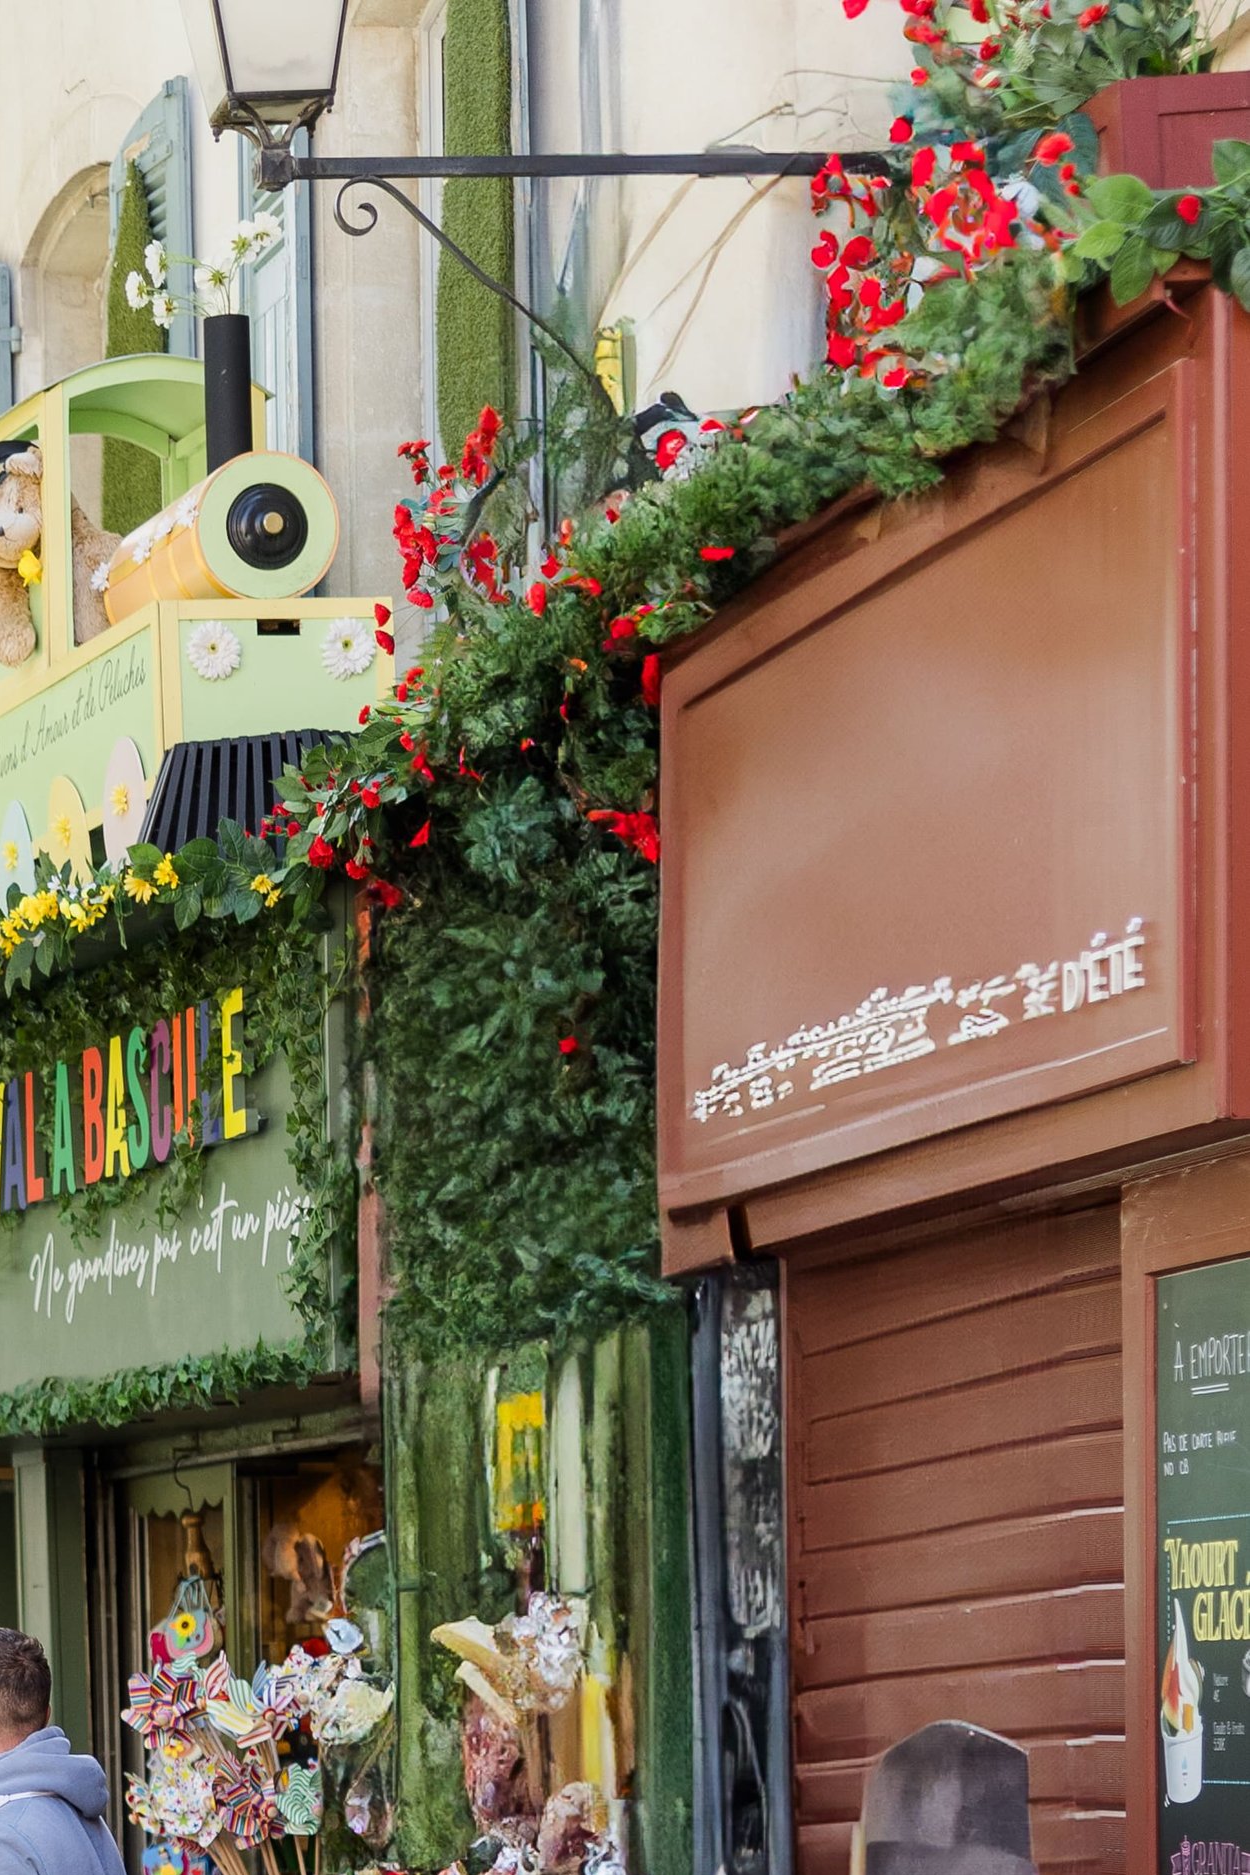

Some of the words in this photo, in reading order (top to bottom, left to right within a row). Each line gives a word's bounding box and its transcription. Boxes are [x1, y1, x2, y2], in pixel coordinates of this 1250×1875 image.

[72, 688, 84, 730] et
[84, 676, 96, 720] de
[99, 644, 146, 711] Peluches
[1062, 917, 1146, 1012] D'ÉTÉ
[82, 987, 247, 1184] BASCULE
[29, 1232, 64, 1318] Ne
[65, 1218, 150, 1324] grandissez
[150, 1230, 181, 1297] pas
[189, 1181, 239, 1273] c'est
[232, 1208, 260, 1241] un
[1173, 1340, 1184, 1382] A
[1190, 1330, 1250, 1380] EMPORTE
[1163, 1431, 1177, 1454] PAS
[1178, 1433, 1188, 1452] DE
[1191, 1432, 1213, 1451] CARTE
[1163, 1462, 1175, 1476] NO
[1164, 1537, 1239, 1591] YAOURT
